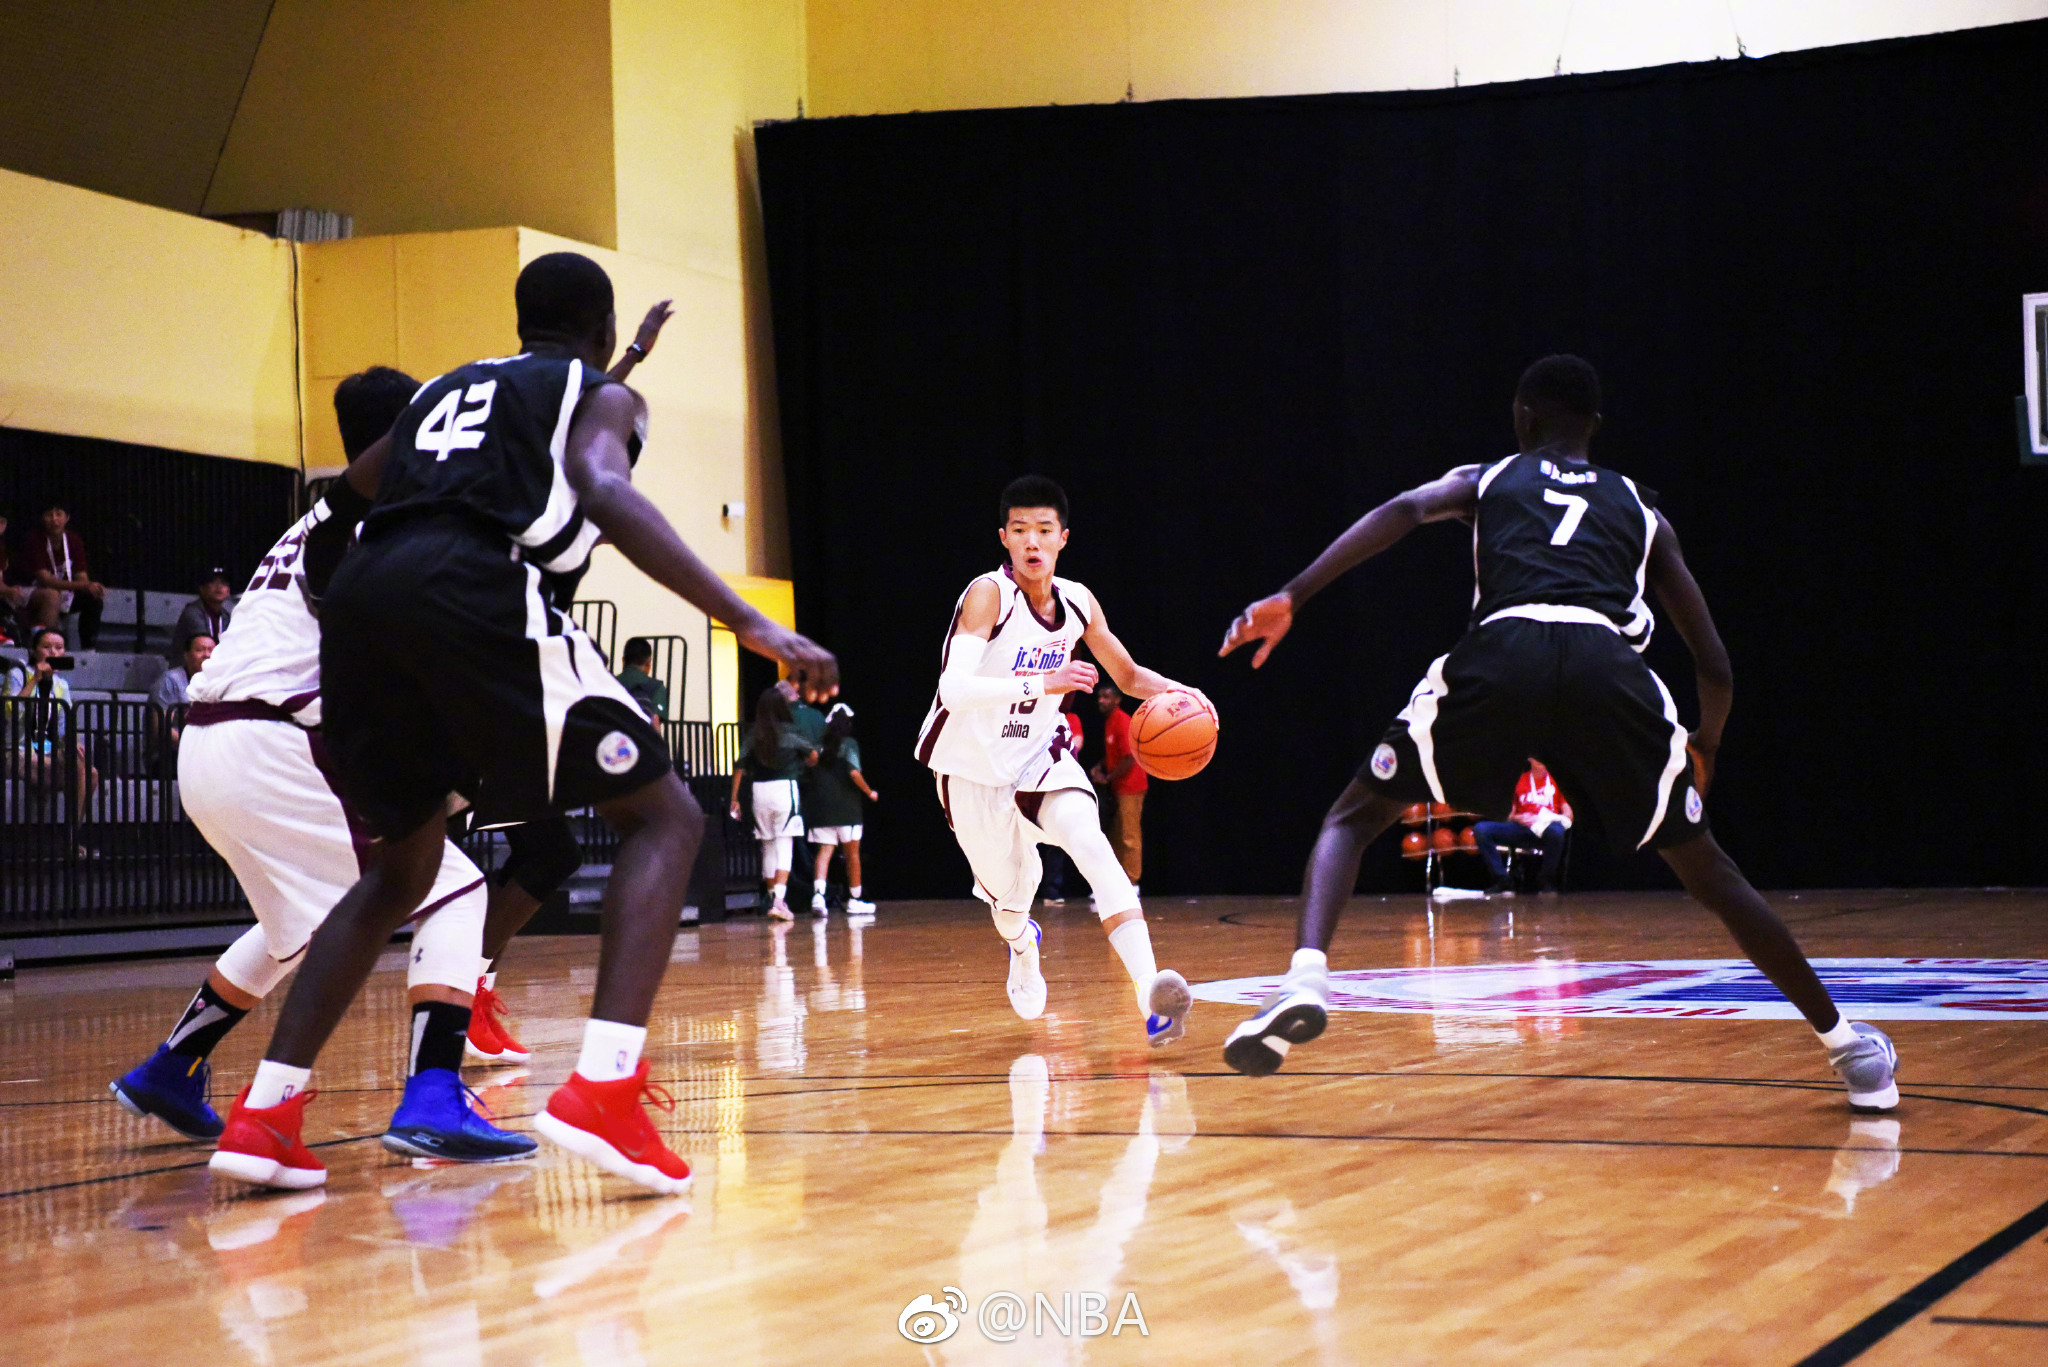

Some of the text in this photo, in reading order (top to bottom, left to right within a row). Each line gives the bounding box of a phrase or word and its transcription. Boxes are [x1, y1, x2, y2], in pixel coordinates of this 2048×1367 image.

[414, 379, 497, 461] 42
[1543, 488, 1589, 546] 7
[1038, 649, 1065, 669] nba
[1001, 720, 1030, 739] china
